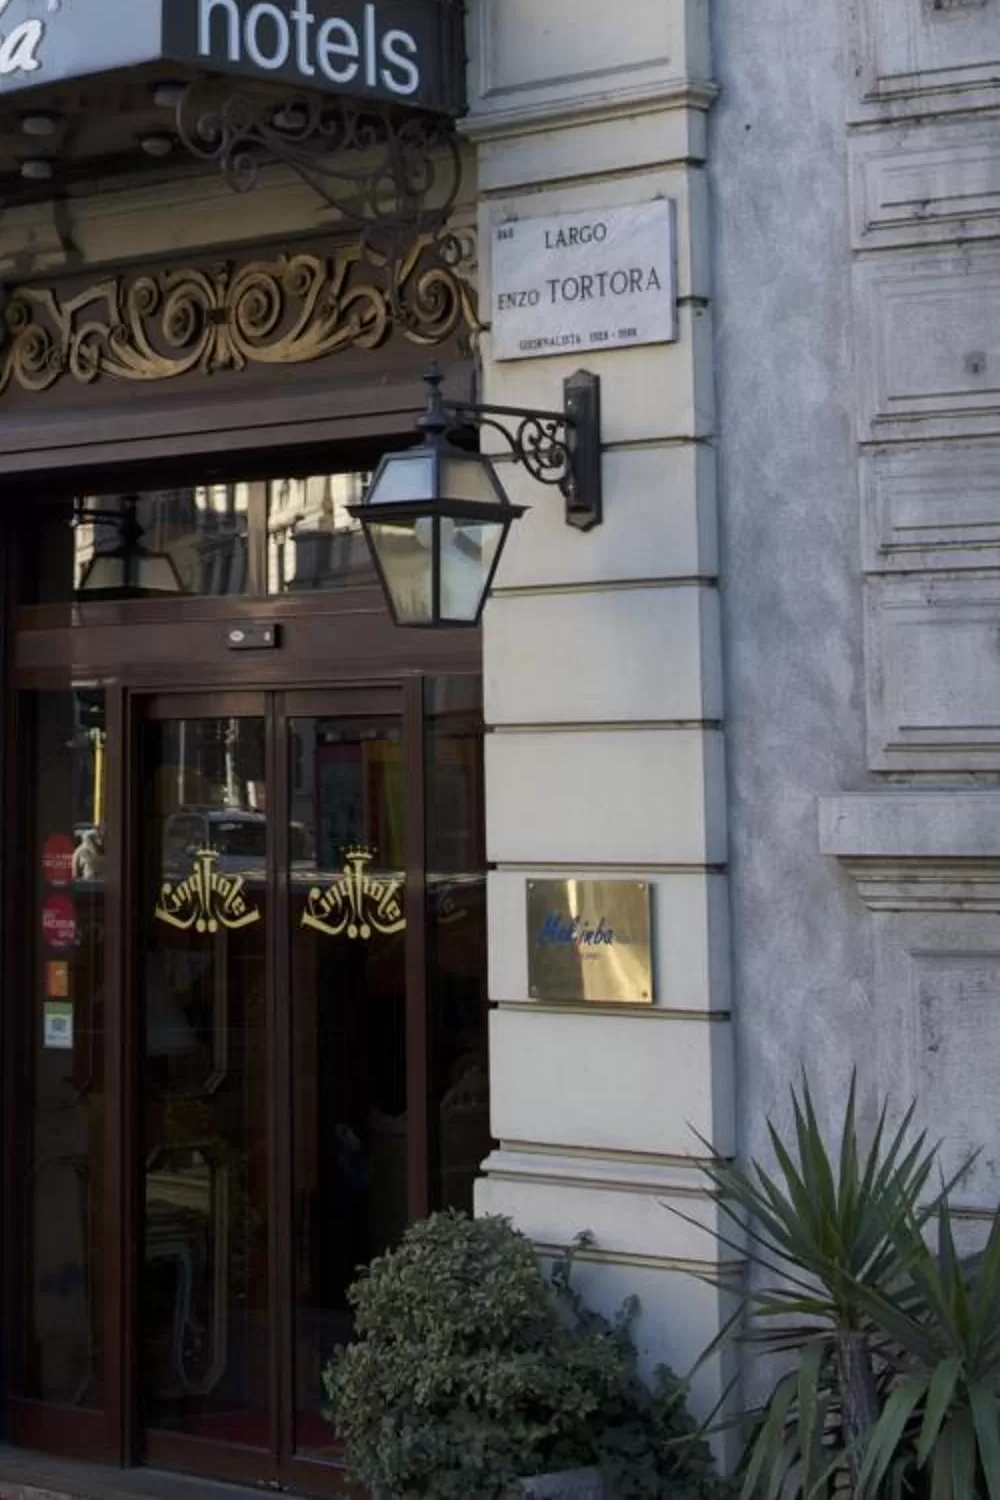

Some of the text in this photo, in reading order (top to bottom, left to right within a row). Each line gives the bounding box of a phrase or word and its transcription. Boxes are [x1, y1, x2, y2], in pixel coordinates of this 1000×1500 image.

[545, 222, 608, 249] LARGO
[497, 266, 662, 310] ENZO TORTORA
